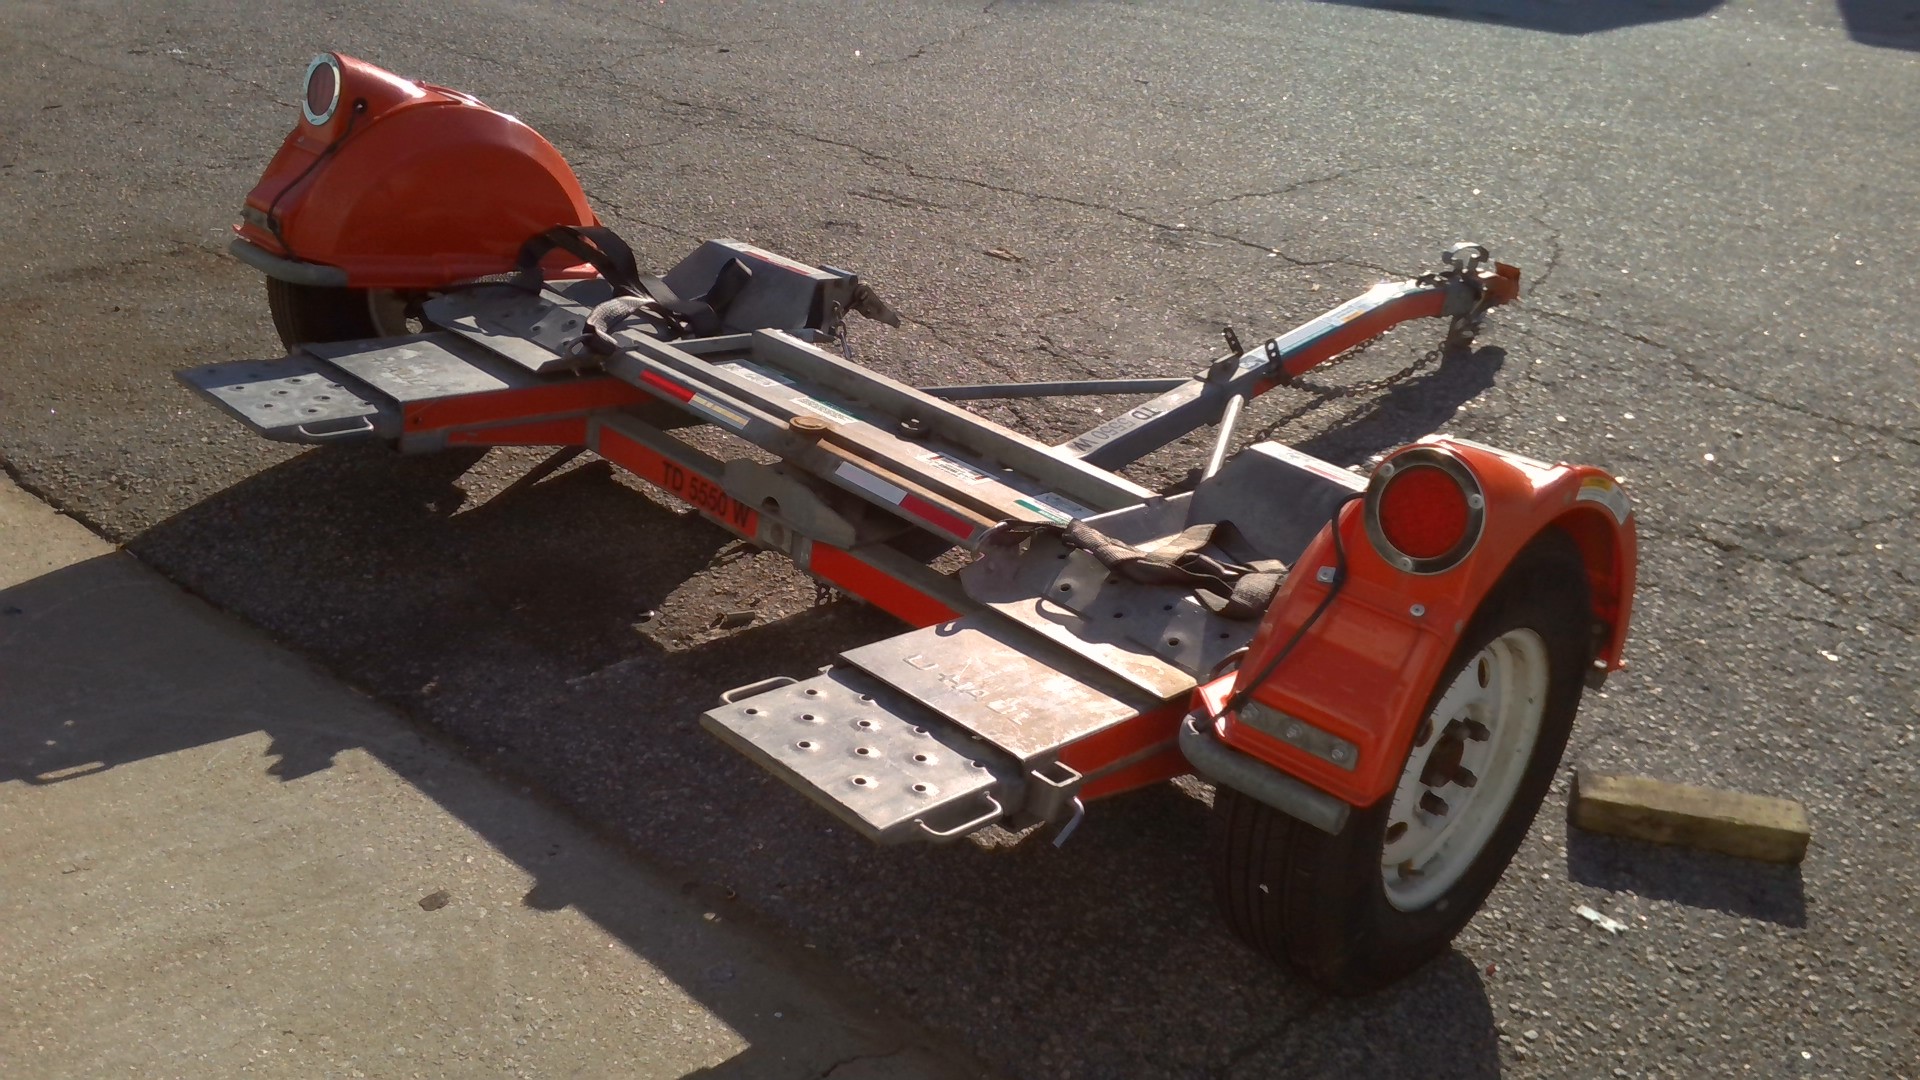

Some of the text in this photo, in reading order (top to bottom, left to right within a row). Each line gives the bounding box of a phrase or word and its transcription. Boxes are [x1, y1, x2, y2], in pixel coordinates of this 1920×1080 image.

[1072, 407, 1162, 452] TD 5550 W
[662, 460, 750, 527] TD 5550 W
